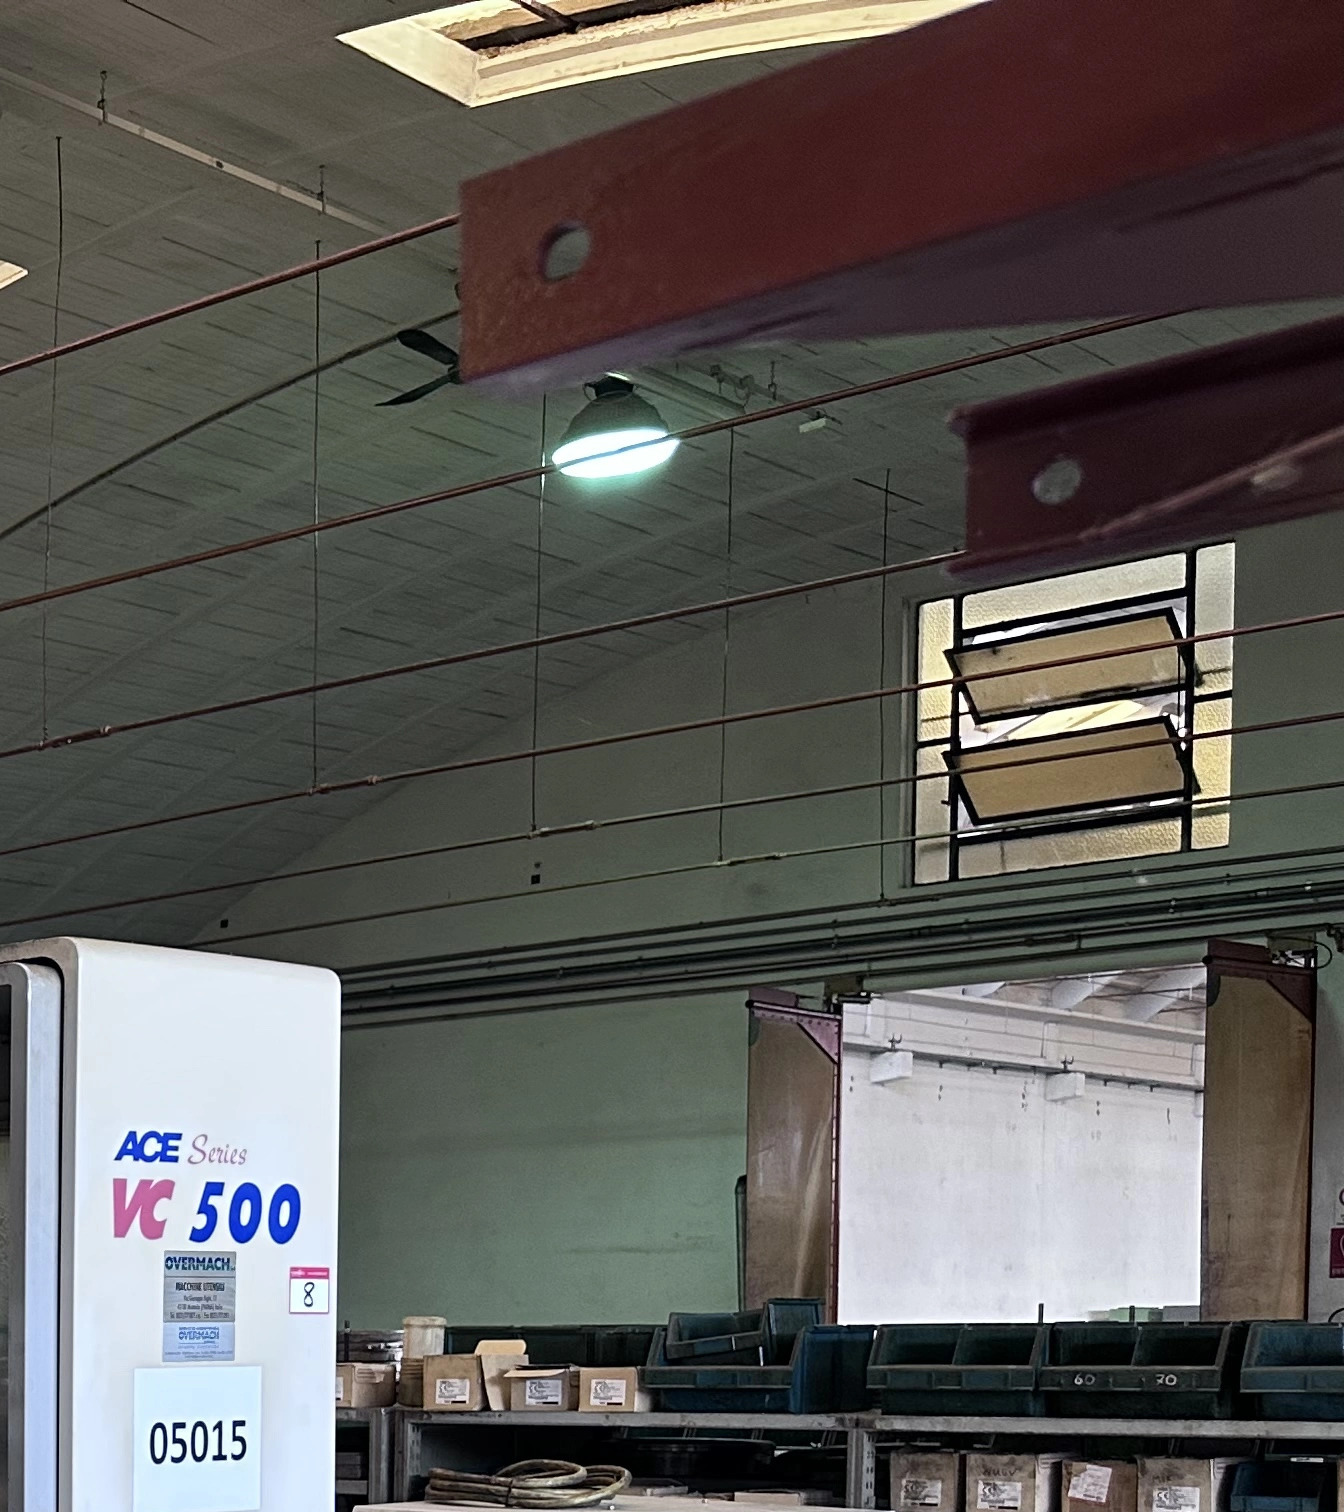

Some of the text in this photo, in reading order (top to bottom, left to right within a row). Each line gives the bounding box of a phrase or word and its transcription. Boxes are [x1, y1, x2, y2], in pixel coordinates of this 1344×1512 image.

[114, 1130, 248, 1166] ACE Series
[113, 1178, 302, 1245] VC 500
[165, 1256, 231, 1271] OVERMACH
[303, 1281, 315, 1308] 8
[178, 1330, 220, 1340] OVERMACH
[1073, 1373, 1096, 1386] 60
[1155, 1373, 1178, 1386] 70
[149, 1420, 247, 1465] 05015
